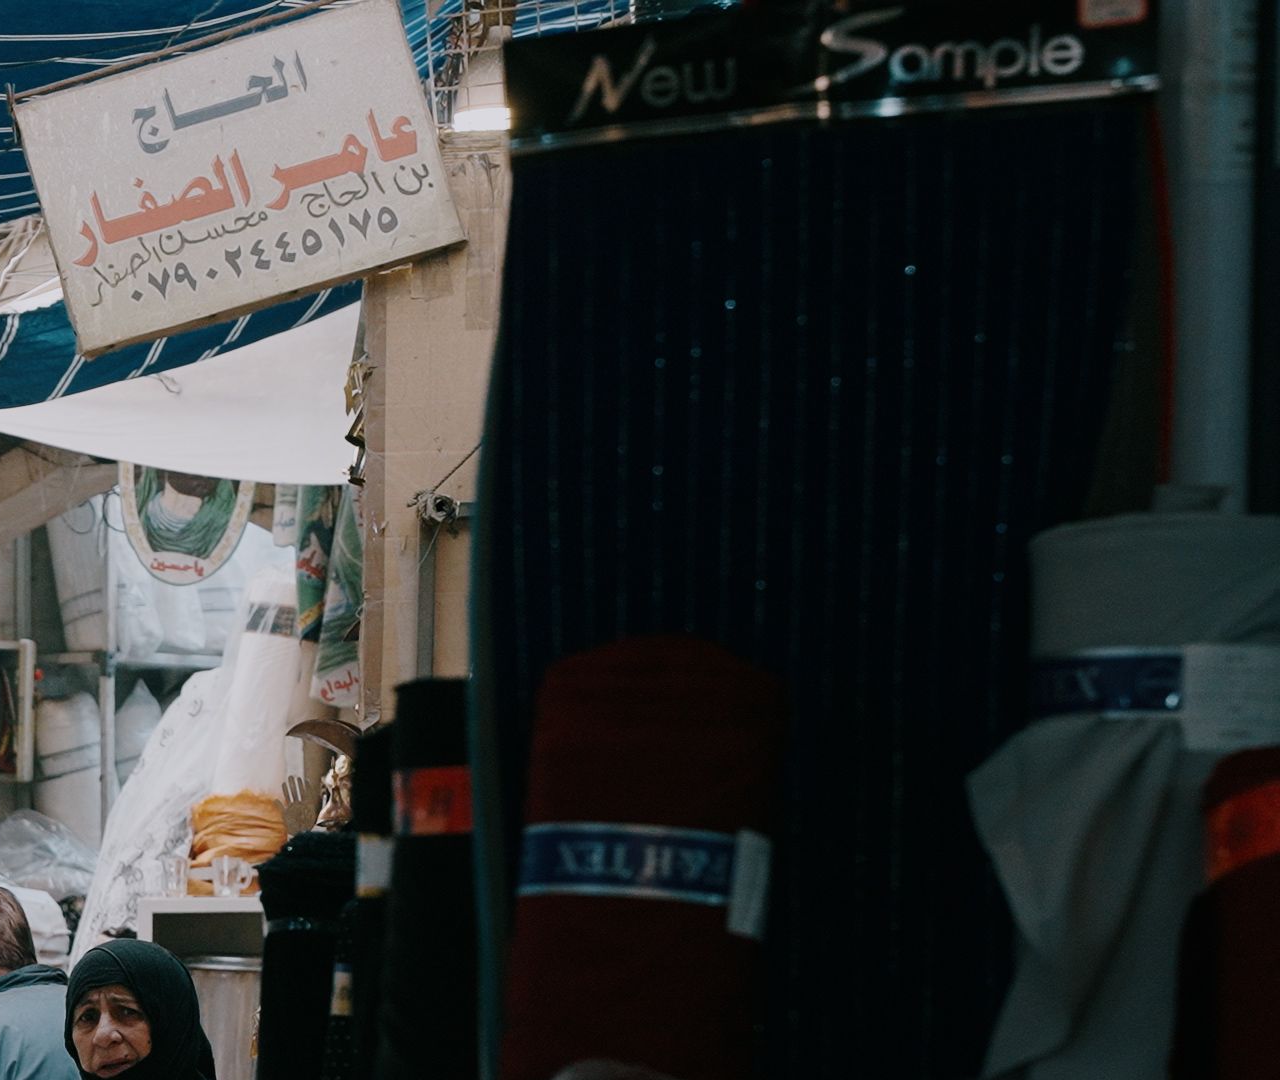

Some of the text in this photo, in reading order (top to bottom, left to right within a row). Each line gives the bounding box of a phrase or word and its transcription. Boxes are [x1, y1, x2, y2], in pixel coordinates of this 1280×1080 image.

[132, 50, 307, 154] الحاج
[566, 5, 1085, 125] New Sample
[73, 108, 417, 267] عامر الصفار
[300, 171, 385, 218] الحاج
[393, 163, 434, 195] بن
